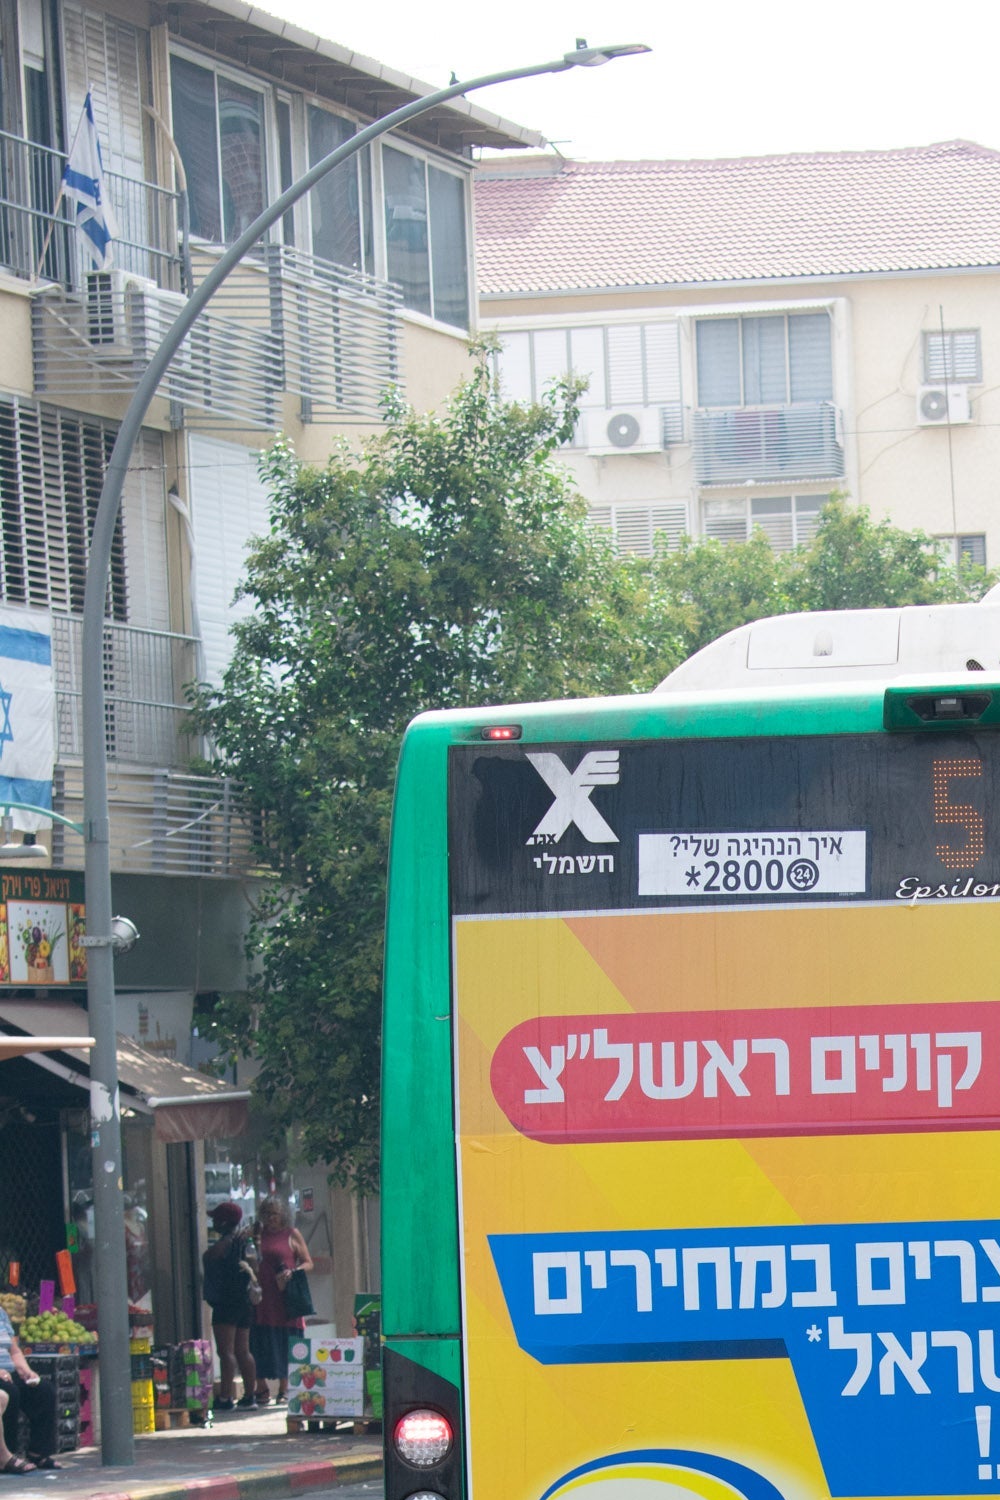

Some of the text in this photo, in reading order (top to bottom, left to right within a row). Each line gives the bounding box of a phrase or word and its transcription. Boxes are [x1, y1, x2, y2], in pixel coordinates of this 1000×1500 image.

[669, 835, 843, 861] איך הנהיגה שלי?
[933, 759, 984, 869] 5
[2, 871, 70, 901] דניאל פרי וירק
[533, 853, 614, 874] חשמלי
[522, 1029, 790, 1104] ראשל"צ
[811, 1031, 982, 1108] קונים
[532, 1244, 837, 1315] במחירים
